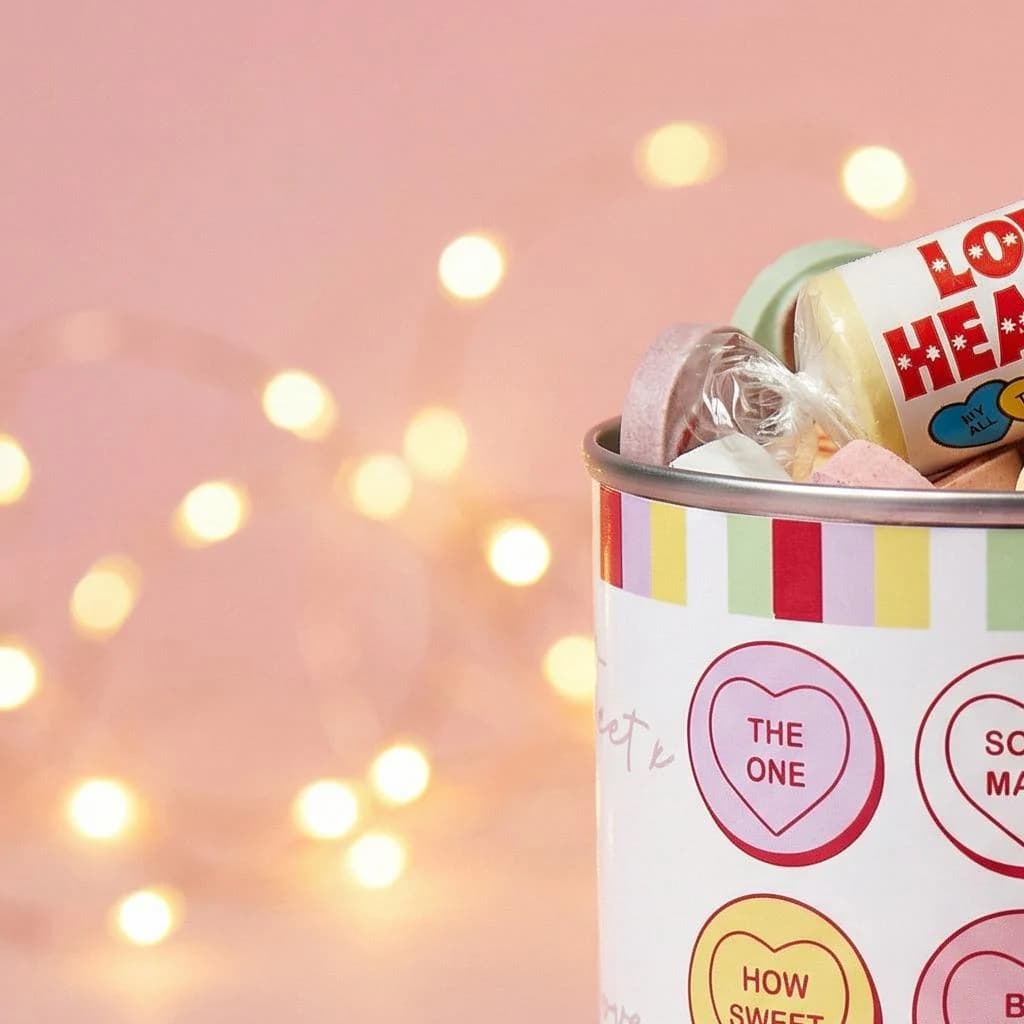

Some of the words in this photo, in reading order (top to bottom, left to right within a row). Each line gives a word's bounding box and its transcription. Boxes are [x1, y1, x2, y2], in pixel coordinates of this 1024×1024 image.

[968, 418, 998, 437] ALL
[747, 717, 804, 748] THE
[746, 757, 806, 788] ONE
[742, 966, 809, 999] HOW
